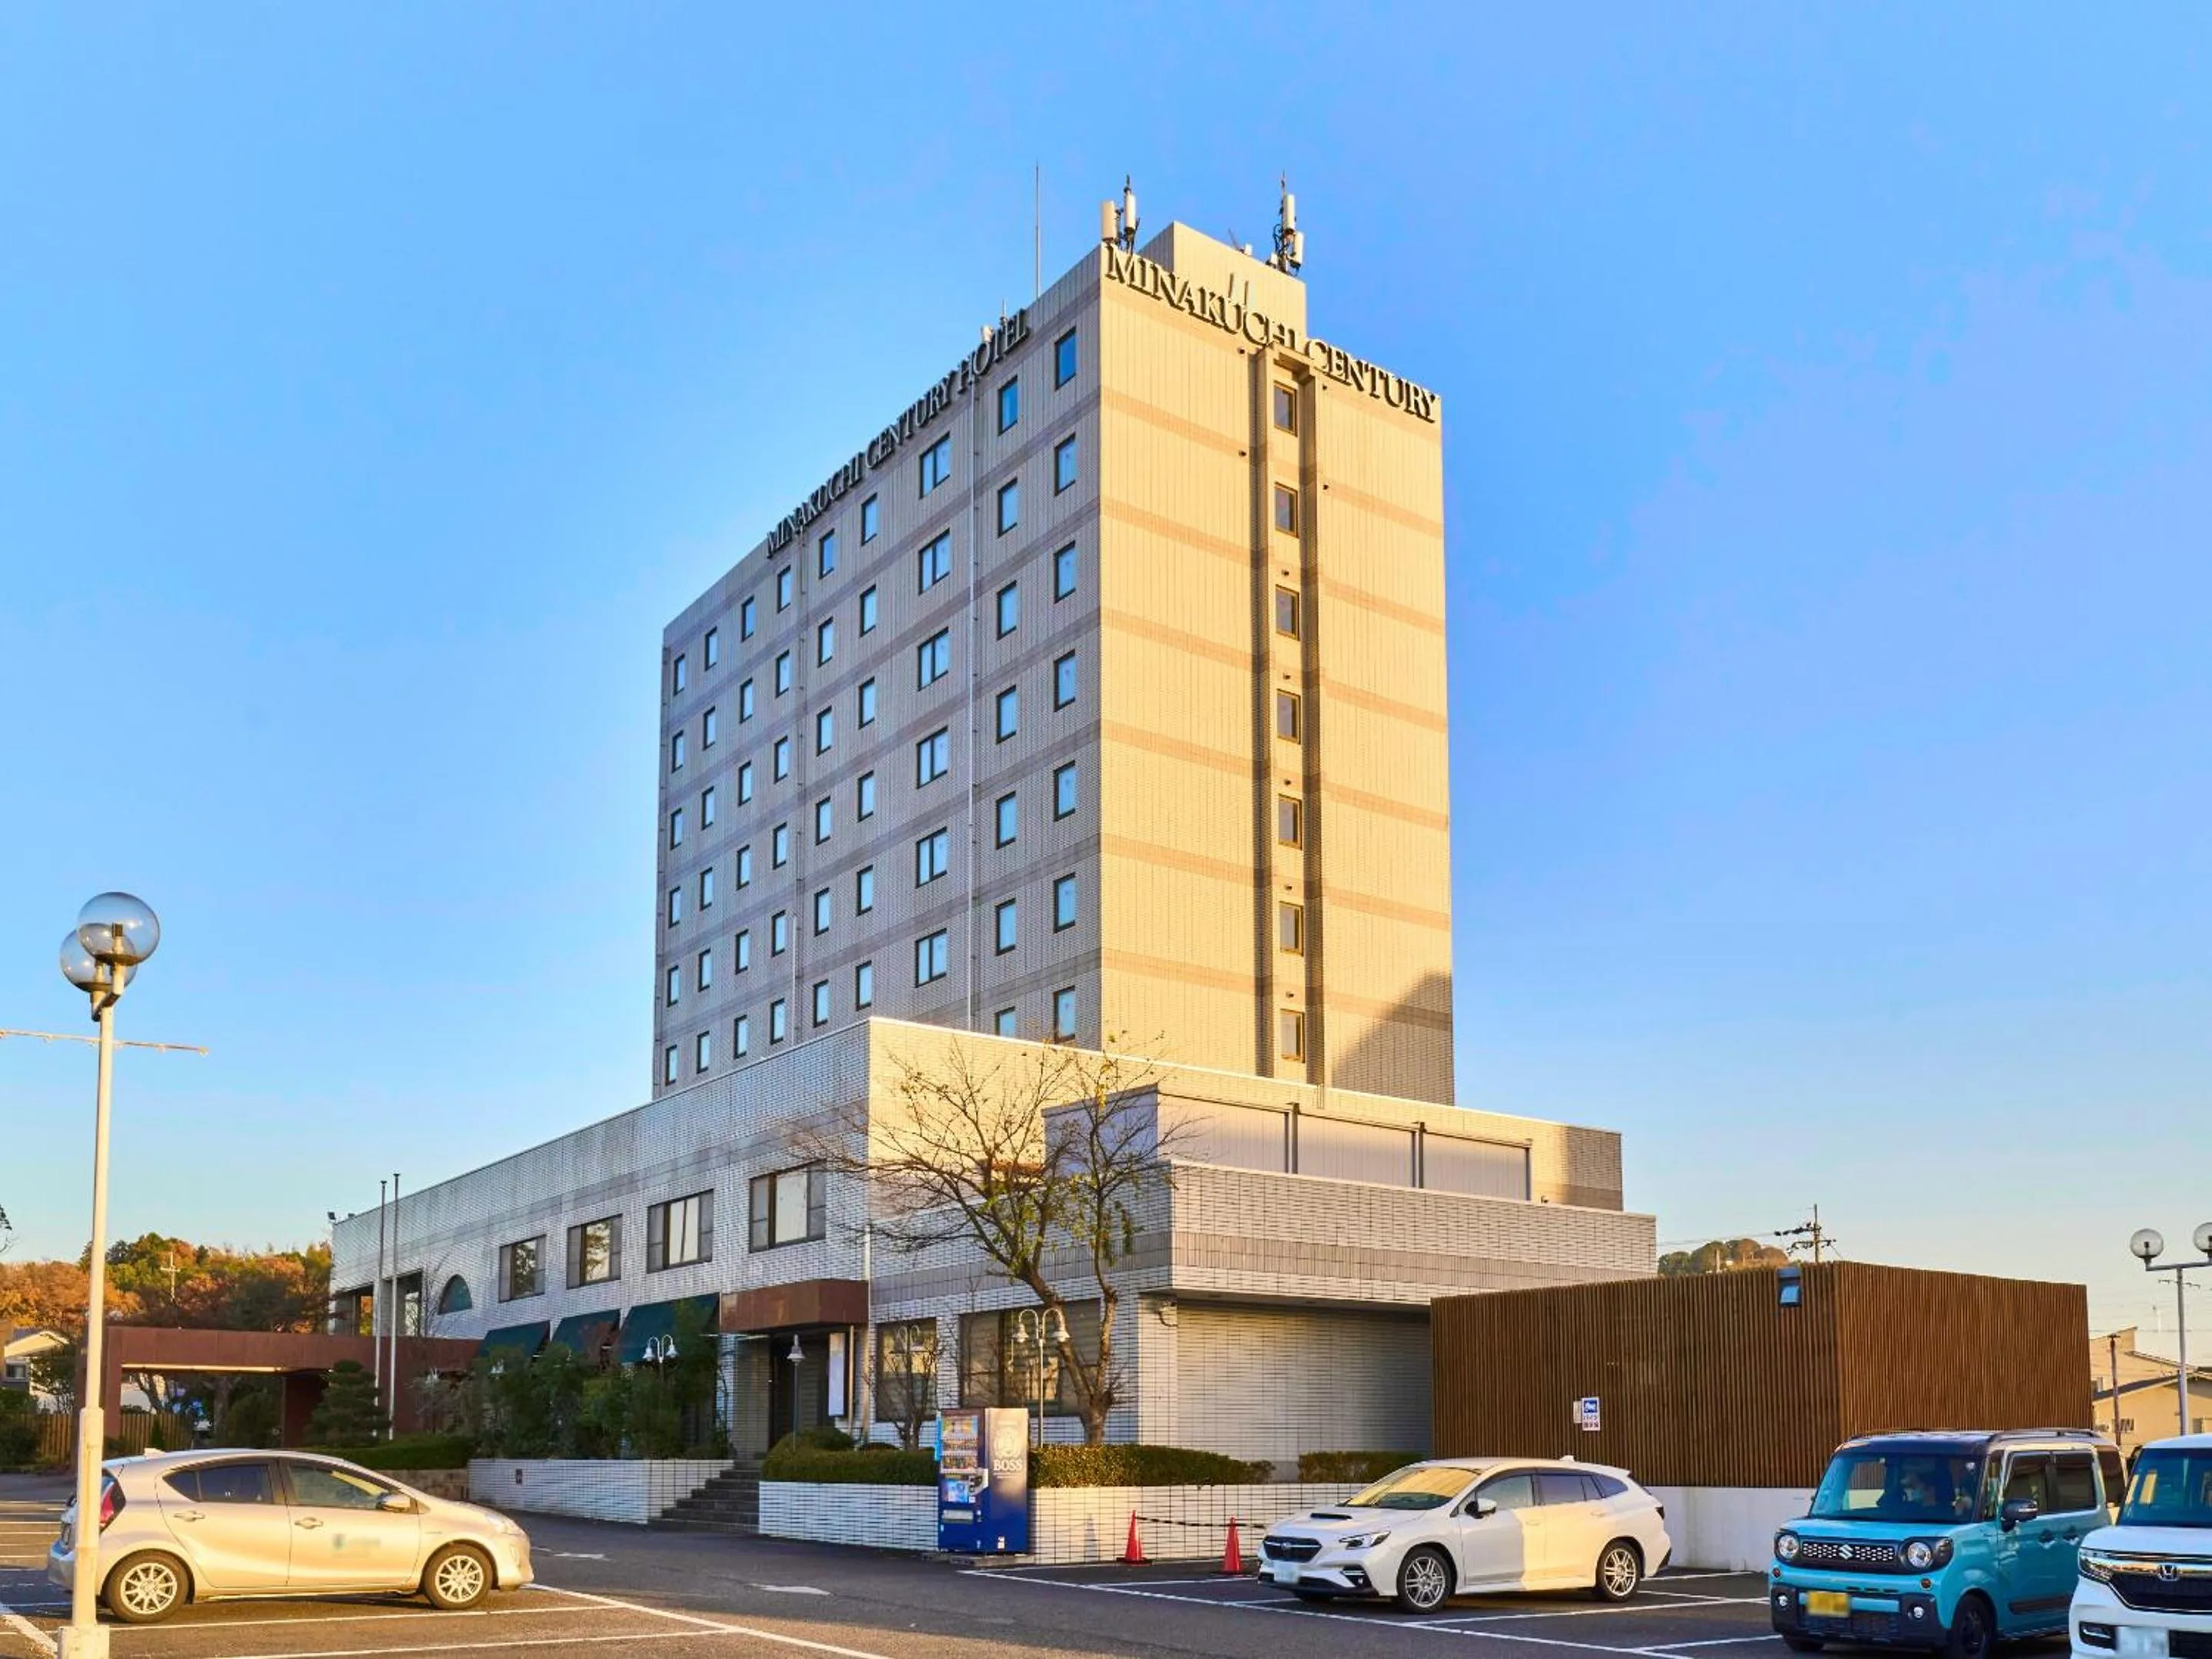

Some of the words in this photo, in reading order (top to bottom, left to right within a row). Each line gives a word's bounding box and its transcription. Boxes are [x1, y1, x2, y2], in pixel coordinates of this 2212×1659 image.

[1103, 243, 1300, 350] MINAKUCHI
[1303, 338, 1438, 423] CENTURY
[767, 452, 863, 559] MINAKUCHI
[865, 369, 959, 471] CENTURY
[957, 307, 1031, 395] HOTEL
[993, 1459, 1023, 1472] BOSS
